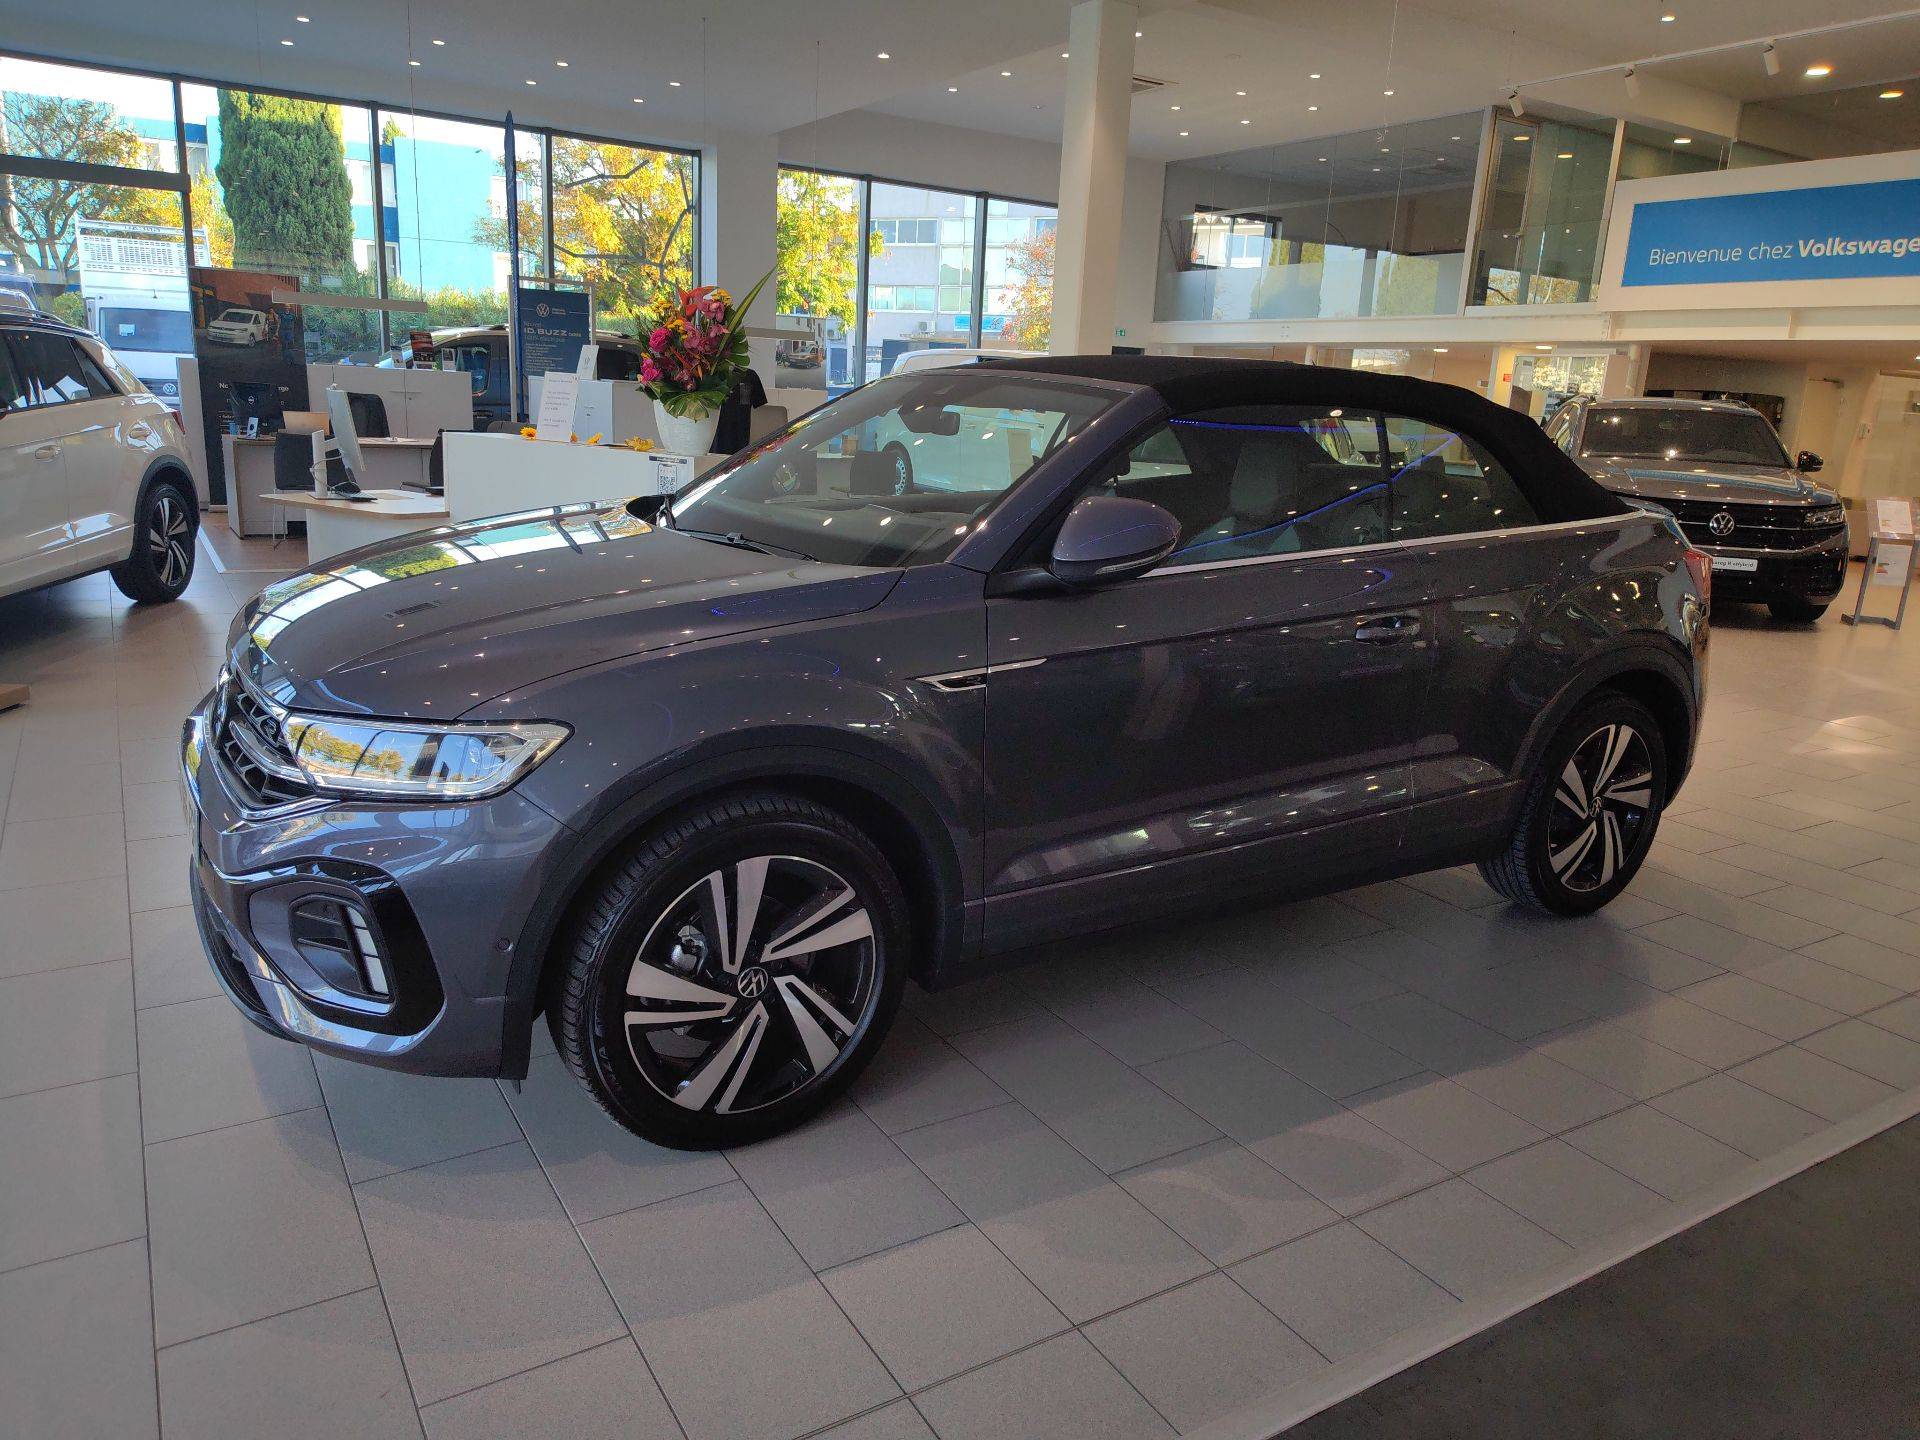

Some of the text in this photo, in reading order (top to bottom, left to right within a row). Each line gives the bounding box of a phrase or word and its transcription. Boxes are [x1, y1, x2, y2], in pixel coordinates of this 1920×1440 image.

[1648, 236, 1920, 266] Bienvenue chez Volkswage
